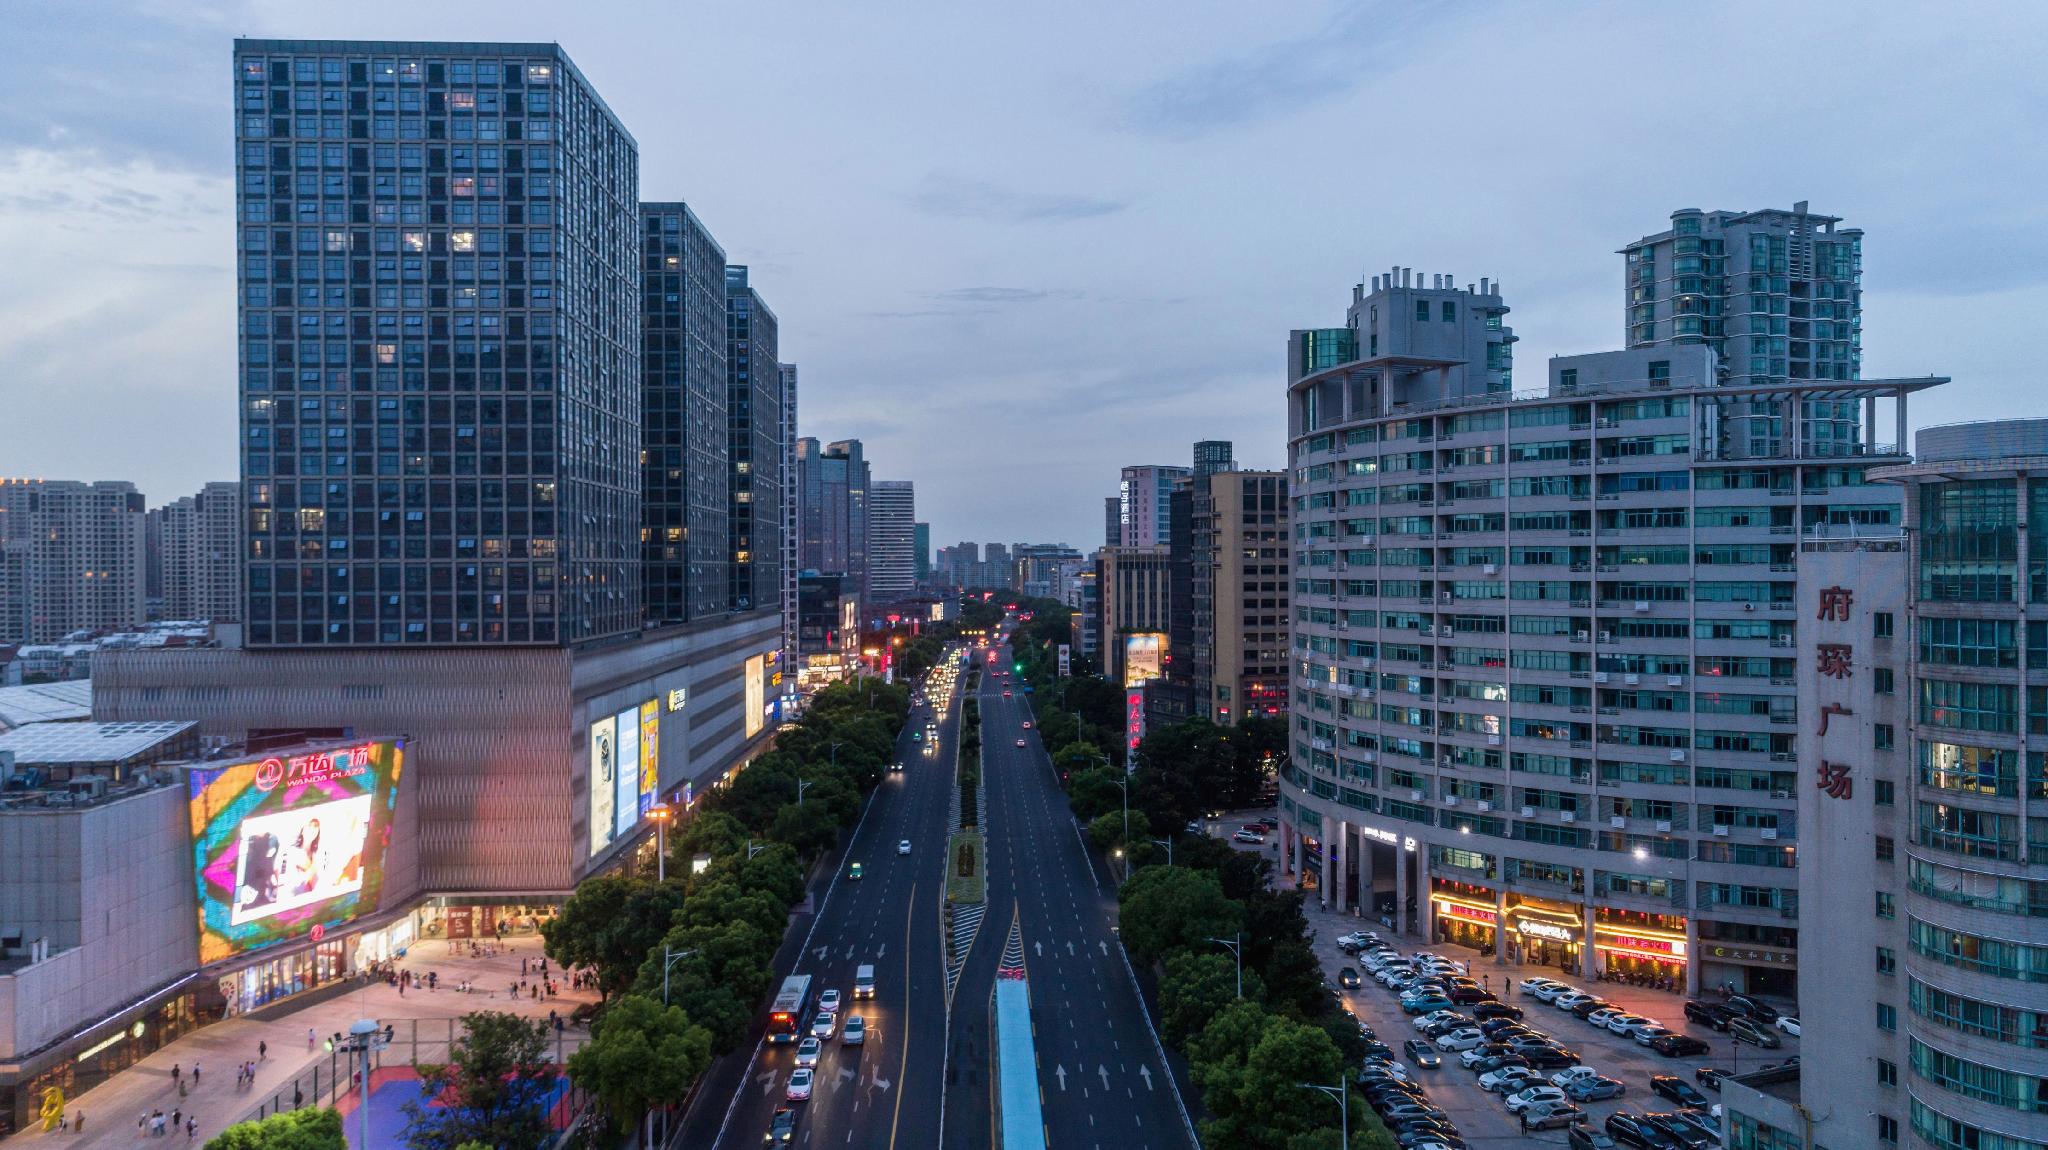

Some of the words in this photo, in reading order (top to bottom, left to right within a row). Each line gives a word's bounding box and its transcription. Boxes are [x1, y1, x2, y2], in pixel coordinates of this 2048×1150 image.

[1816, 586, 1853, 801] 府琛广场
[288, 747, 368, 777] 万达广场
[287, 775, 327, 786] WANDA
[330, 768, 365, 779] PLAZA
[1616, 936, 1671, 952] 川味老火锅
